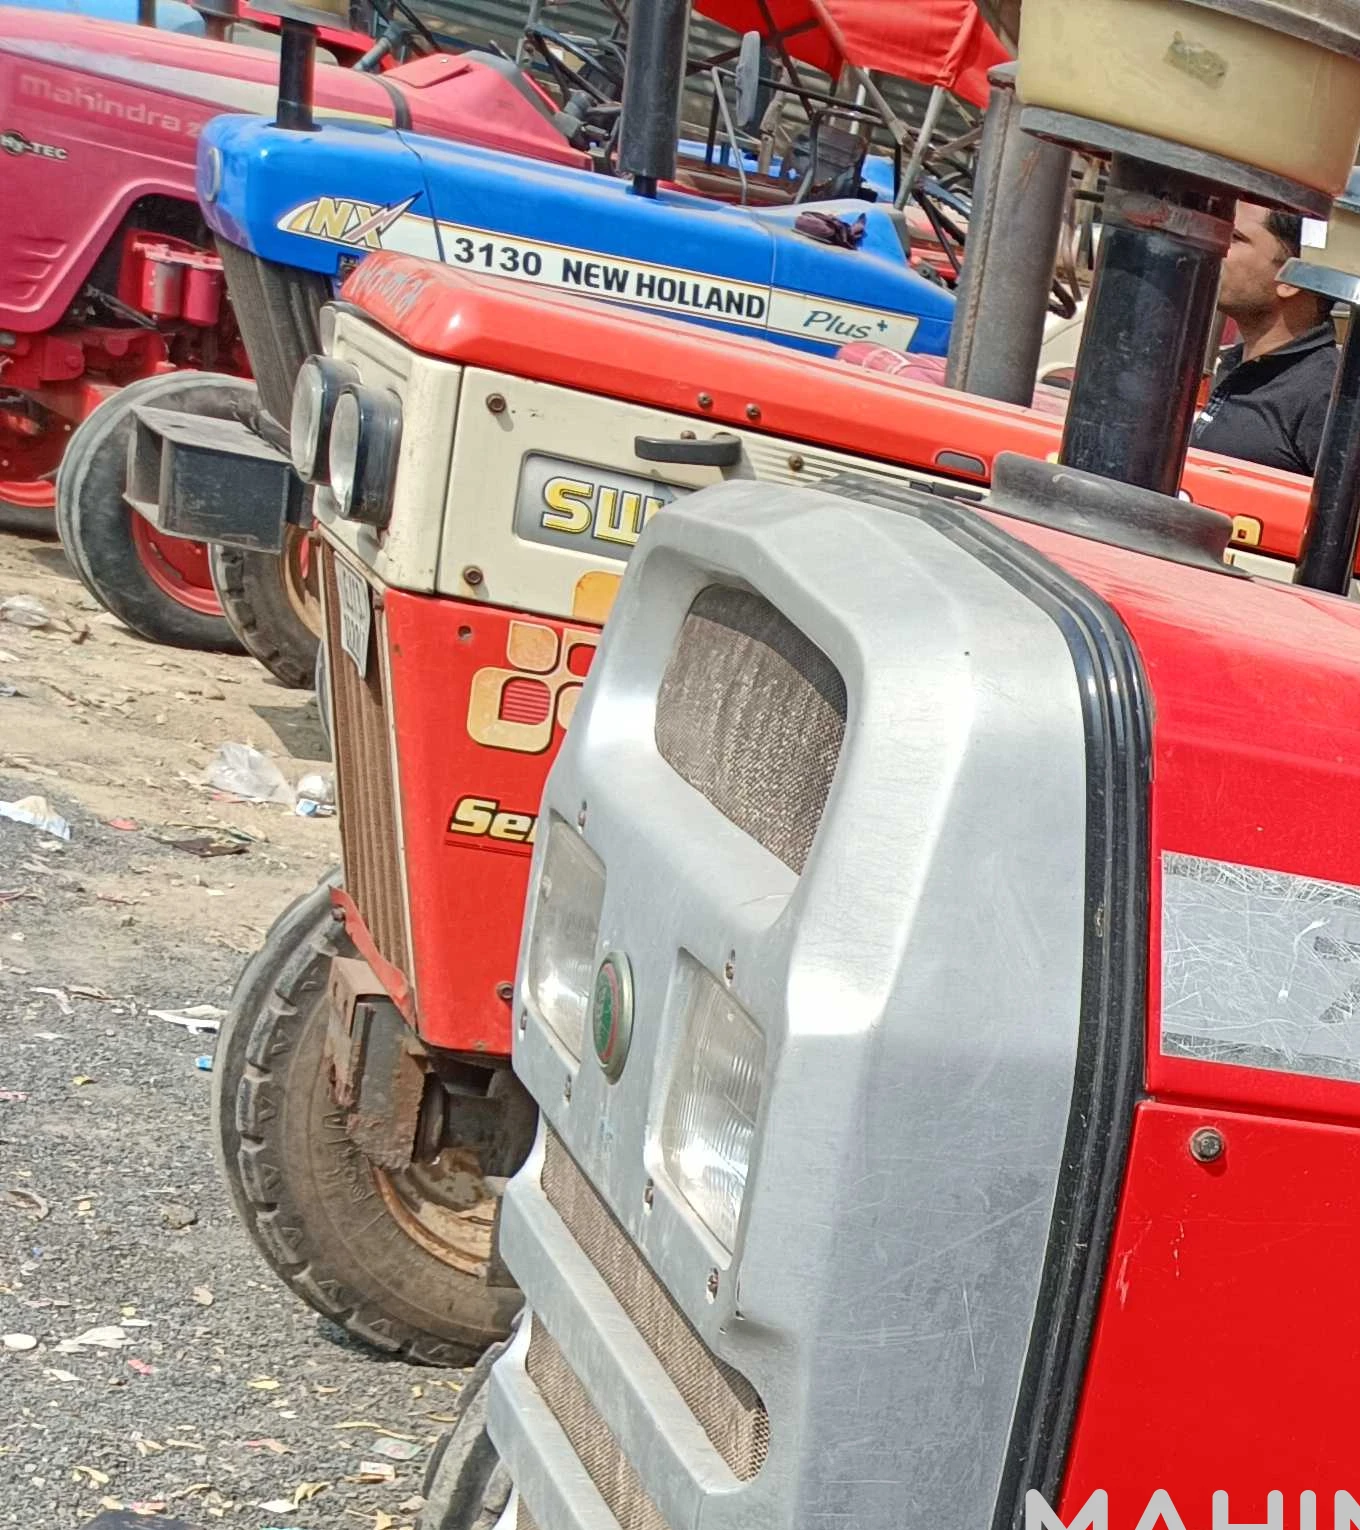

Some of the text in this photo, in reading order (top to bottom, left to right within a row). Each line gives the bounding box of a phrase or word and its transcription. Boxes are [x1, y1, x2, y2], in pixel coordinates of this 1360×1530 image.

[308, 193, 408, 249] NX
[453, 237, 542, 276] 3130
[561, 257, 629, 293] NEW
[635, 272, 767, 320] HOLLAND
[540, 475, 665, 547] SW
